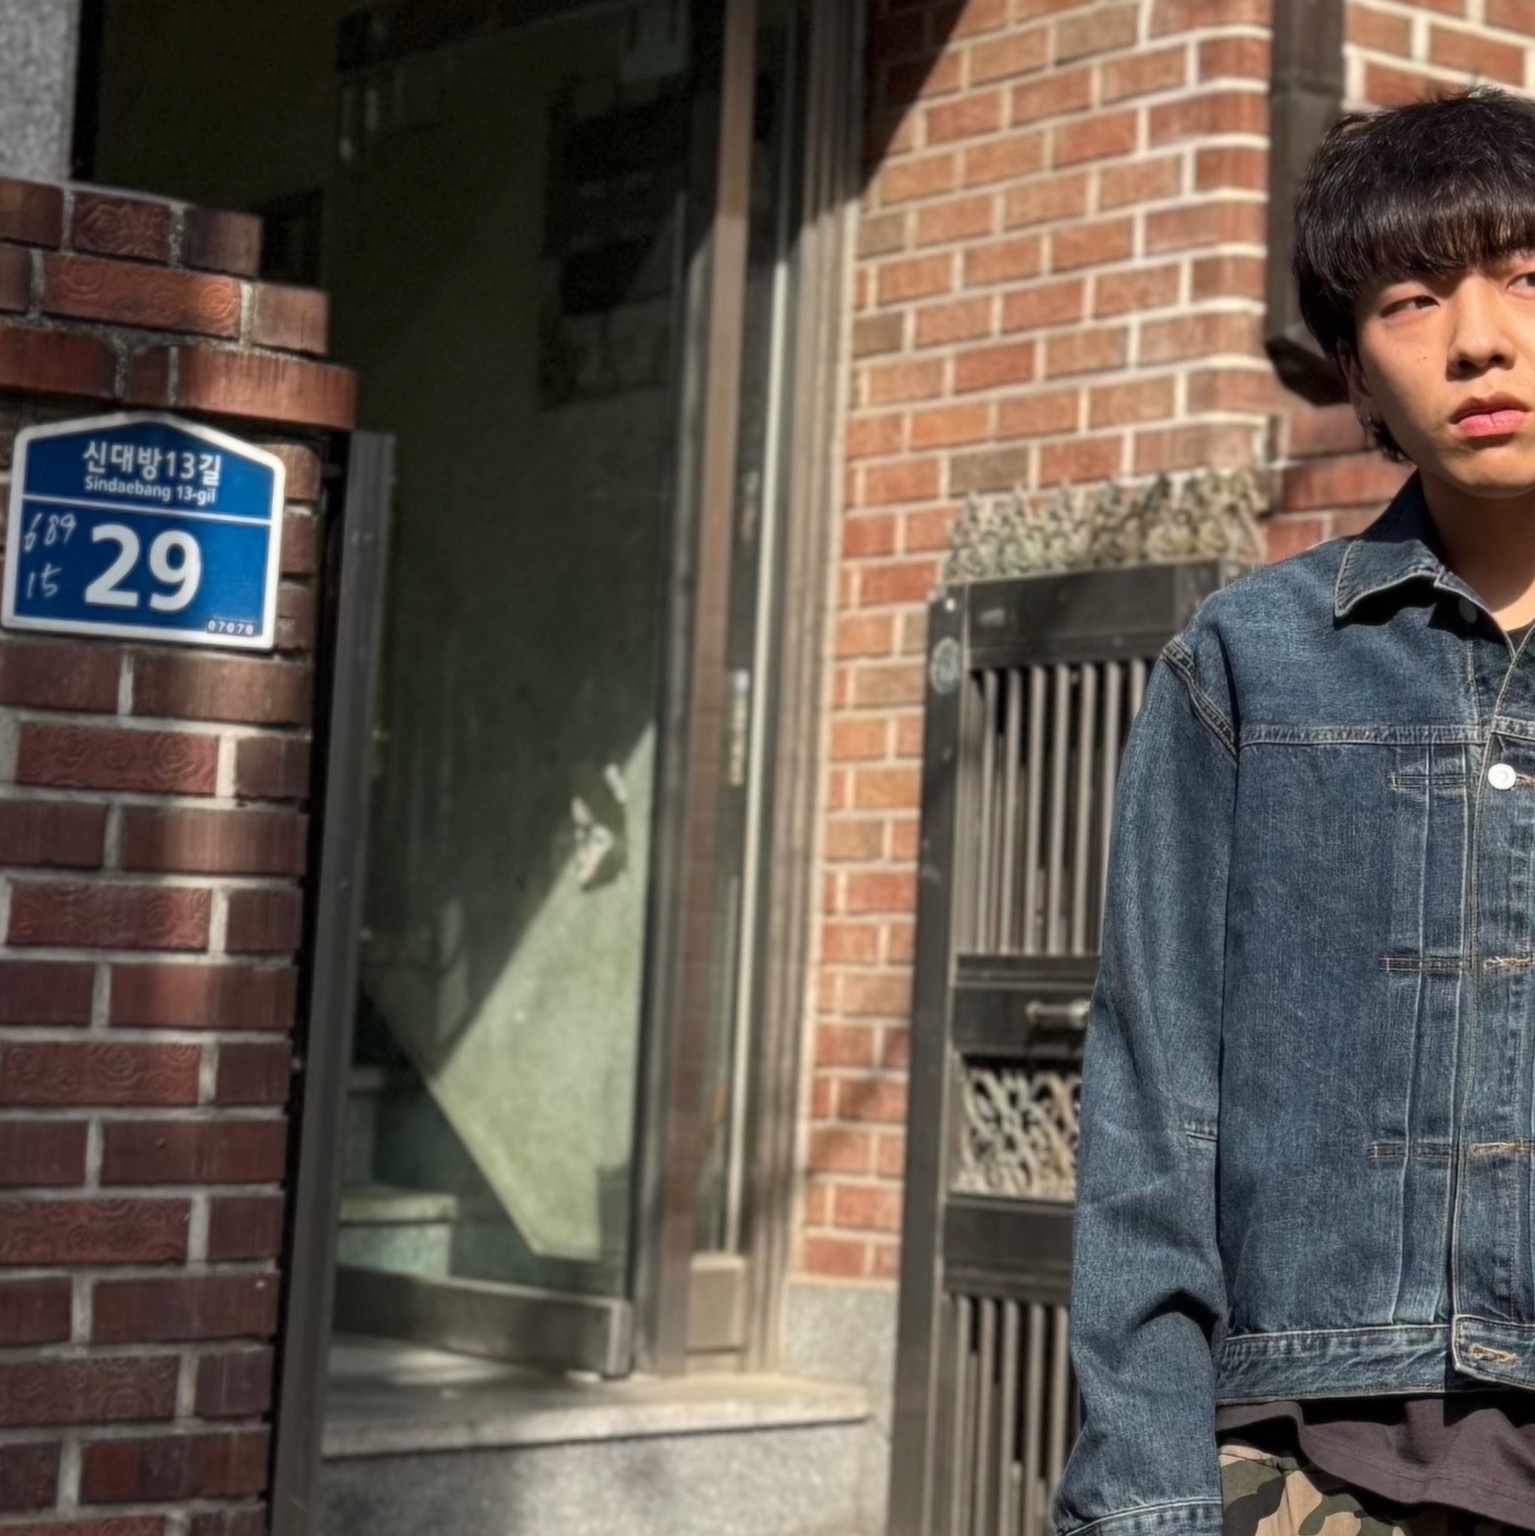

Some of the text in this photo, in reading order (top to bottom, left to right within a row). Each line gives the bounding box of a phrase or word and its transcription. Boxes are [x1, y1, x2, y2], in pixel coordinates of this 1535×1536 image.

[83, 440, 221, 486] 신대방13길
[85, 475, 216, 505] Sindaebang 13-gil
[84, 523, 202, 611] 29
